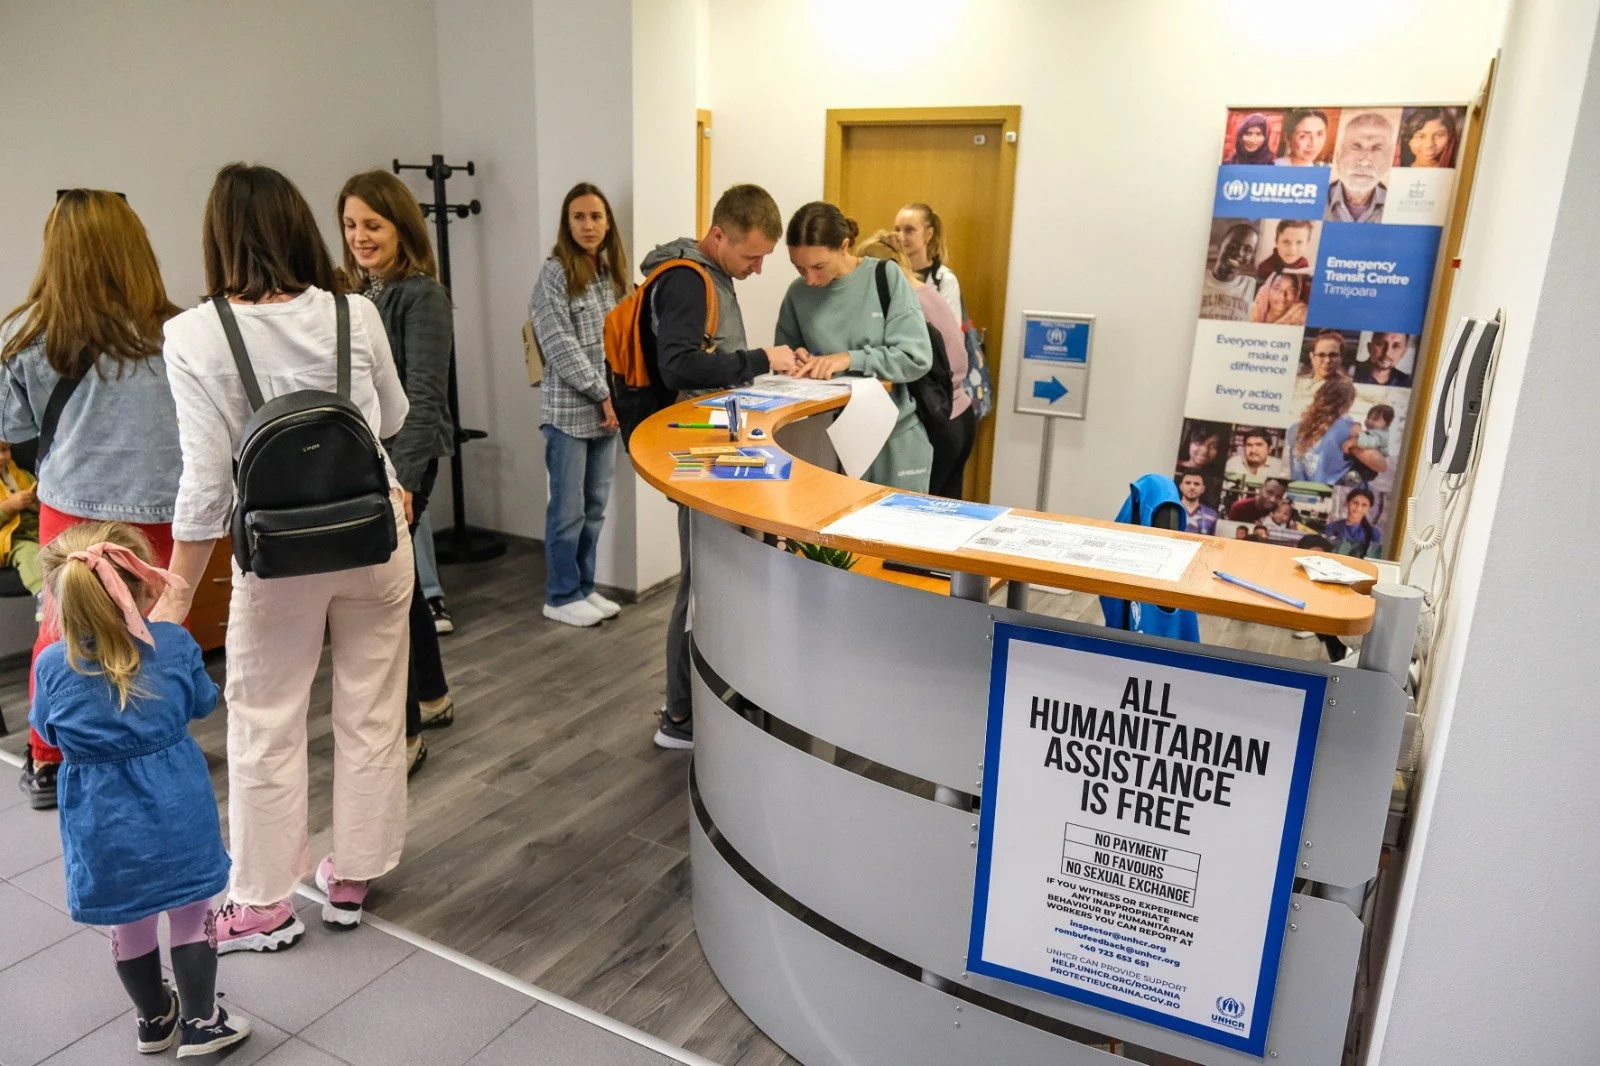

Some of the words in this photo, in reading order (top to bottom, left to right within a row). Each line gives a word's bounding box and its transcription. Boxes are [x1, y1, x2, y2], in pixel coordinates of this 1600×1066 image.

[1250, 182, 1318, 198] UNHCR
[1325, 270, 1365, 284] Transit
[1366, 272, 1410, 285] Centre
[1326, 256, 1396, 274] Emergency
[1216, 334, 1268, 348] Everyone
[1270, 340, 1290, 349] can
[1248, 351, 1279, 361] make
[1281, 354, 1288, 362] a
[1230, 361, 1287, 375] difference
[1216, 384, 1246, 398] Every
[1248, 390, 1282, 400] action
[1242, 402, 1280, 412] counts
[1120, 676, 1177, 719] ALL
[1030, 696, 1270, 776] HUMANITARIAN
[1044, 736, 1235, 807] ASSISTANCE
[1080, 780, 1109, 815] IS
[1116, 788, 1194, 836] FREE
[1095, 832, 1110, 847] NO
[1113, 836, 1168, 862] PAYMENT
[1066, 860, 1081, 875] NO
[1083, 864, 1126, 887] SEXUAL
[1129, 876, 1190, 903] EXCHANGE
[1094, 851, 1110, 866] NO
[1112, 855, 1164, 880] FAVOURS
[1047, 894, 1101, 912] BEHAVIOUR
[1104, 908, 1116, 917] BY
[1118, 912, 1194, 938] HUMANITARIAN
[1058, 880, 1076, 890] YOU
[1078, 885, 1120, 902] WITNESS
[1122, 896, 1136, 906] OR
[1139, 901, 1200, 923] EXPERIENCE
[1071, 892, 1091, 902] ANY
[1093, 897, 1170, 924] INAPPROPRIATE
[1046, 901, 1092, 919] WORKERS
[1095, 915, 1114, 926] YOU
[1116, 921, 1137, 932] CAN
[1139, 927, 1177, 943] REPORT
[1179, 937, 1194, 947] AT
[1070, 920, 1167, 953] inspector@unhcr.org
[1054, 926, 1180, 968] rombufeedback@unhcr.org
[1079, 943, 1096, 953] +40
[1098, 948, 1114, 958] 723
[1116, 953, 1132, 963] 653
[1134, 958, 1150, 968] 651
[1046, 947, 1078, 962] UNHCR
[1079, 956, 1099, 968] CAN
[1101, 962, 1141, 980] PROVIDE
[1143, 973, 1188, 992] SUPPORT
[1052, 958, 1181, 1000] HELP.UNHCR.ORG/ROMANIA
[1050, 966, 1180, 1009] PROTECTIEUCRAINA.GOV.RO
[1211, 1014, 1245, 1029] UNHCR
